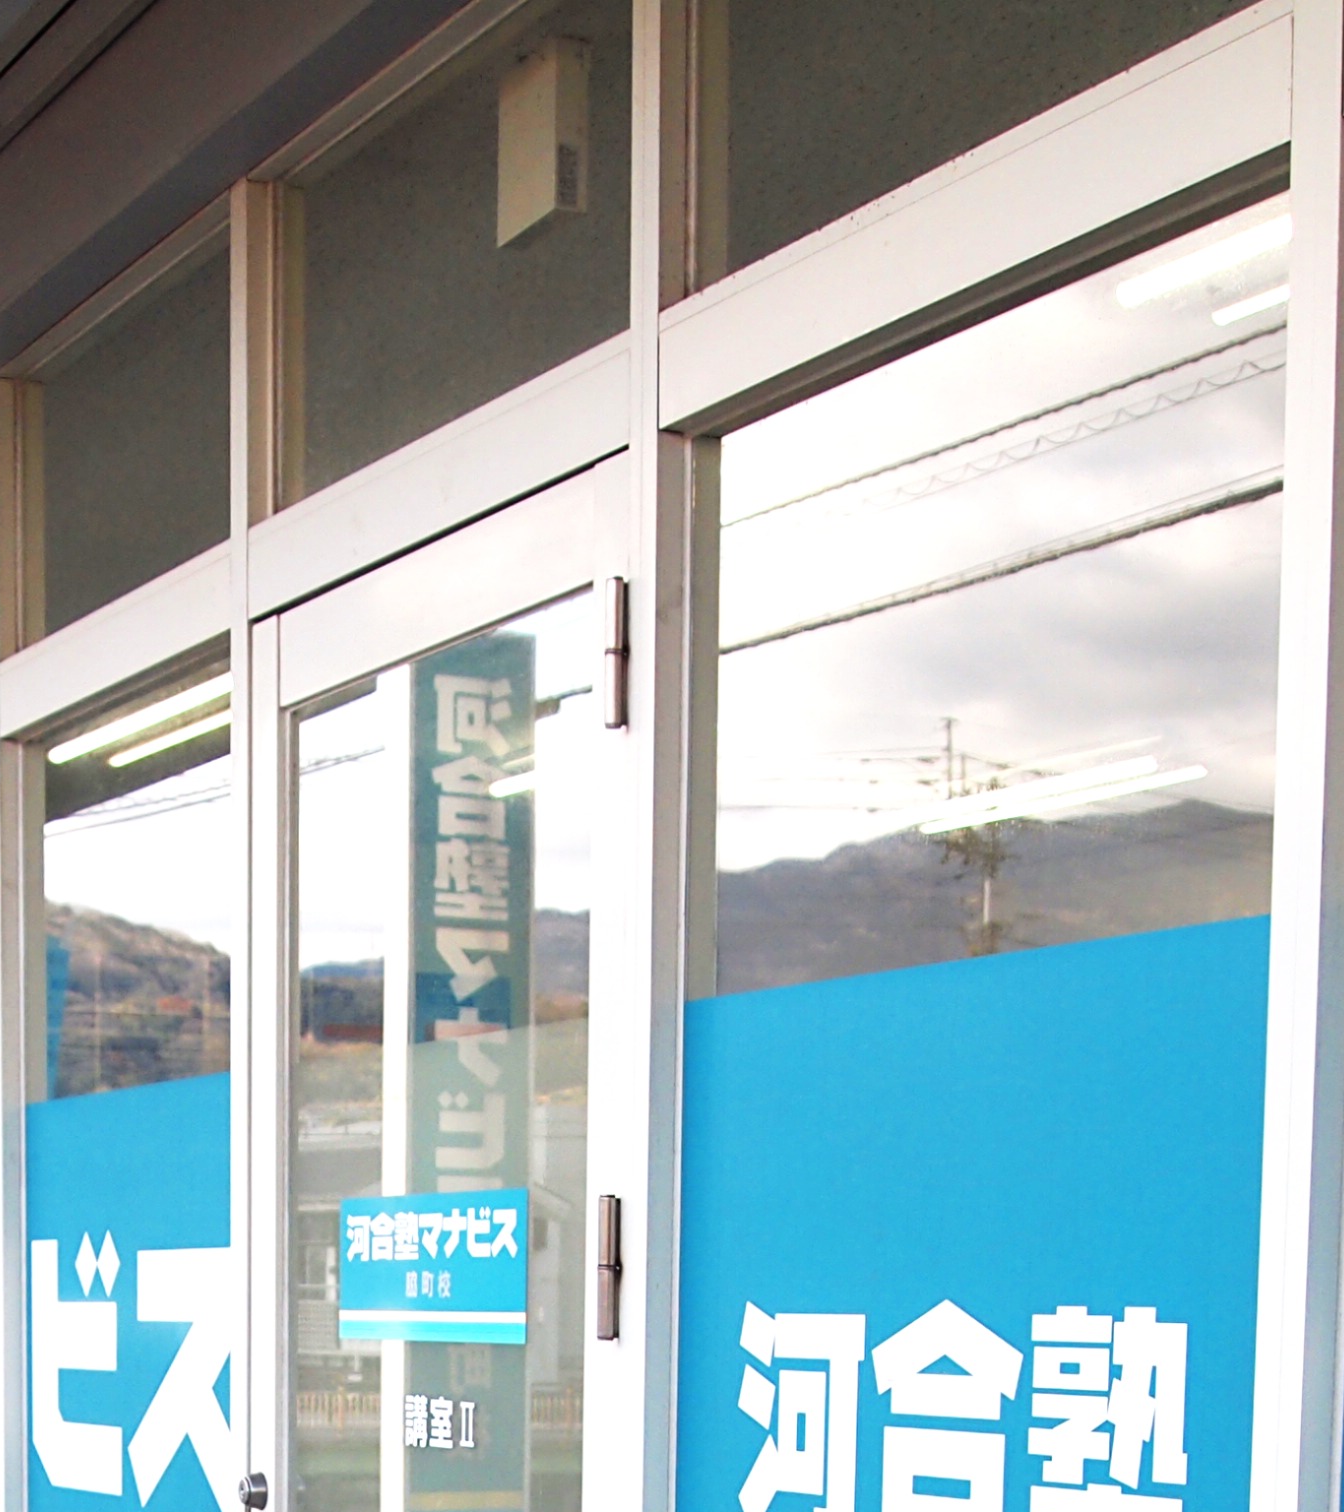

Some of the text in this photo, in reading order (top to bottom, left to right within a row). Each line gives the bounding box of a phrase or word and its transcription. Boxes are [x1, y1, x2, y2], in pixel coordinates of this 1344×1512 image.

[345, 1206, 519, 1263] 河合塾マナビス
